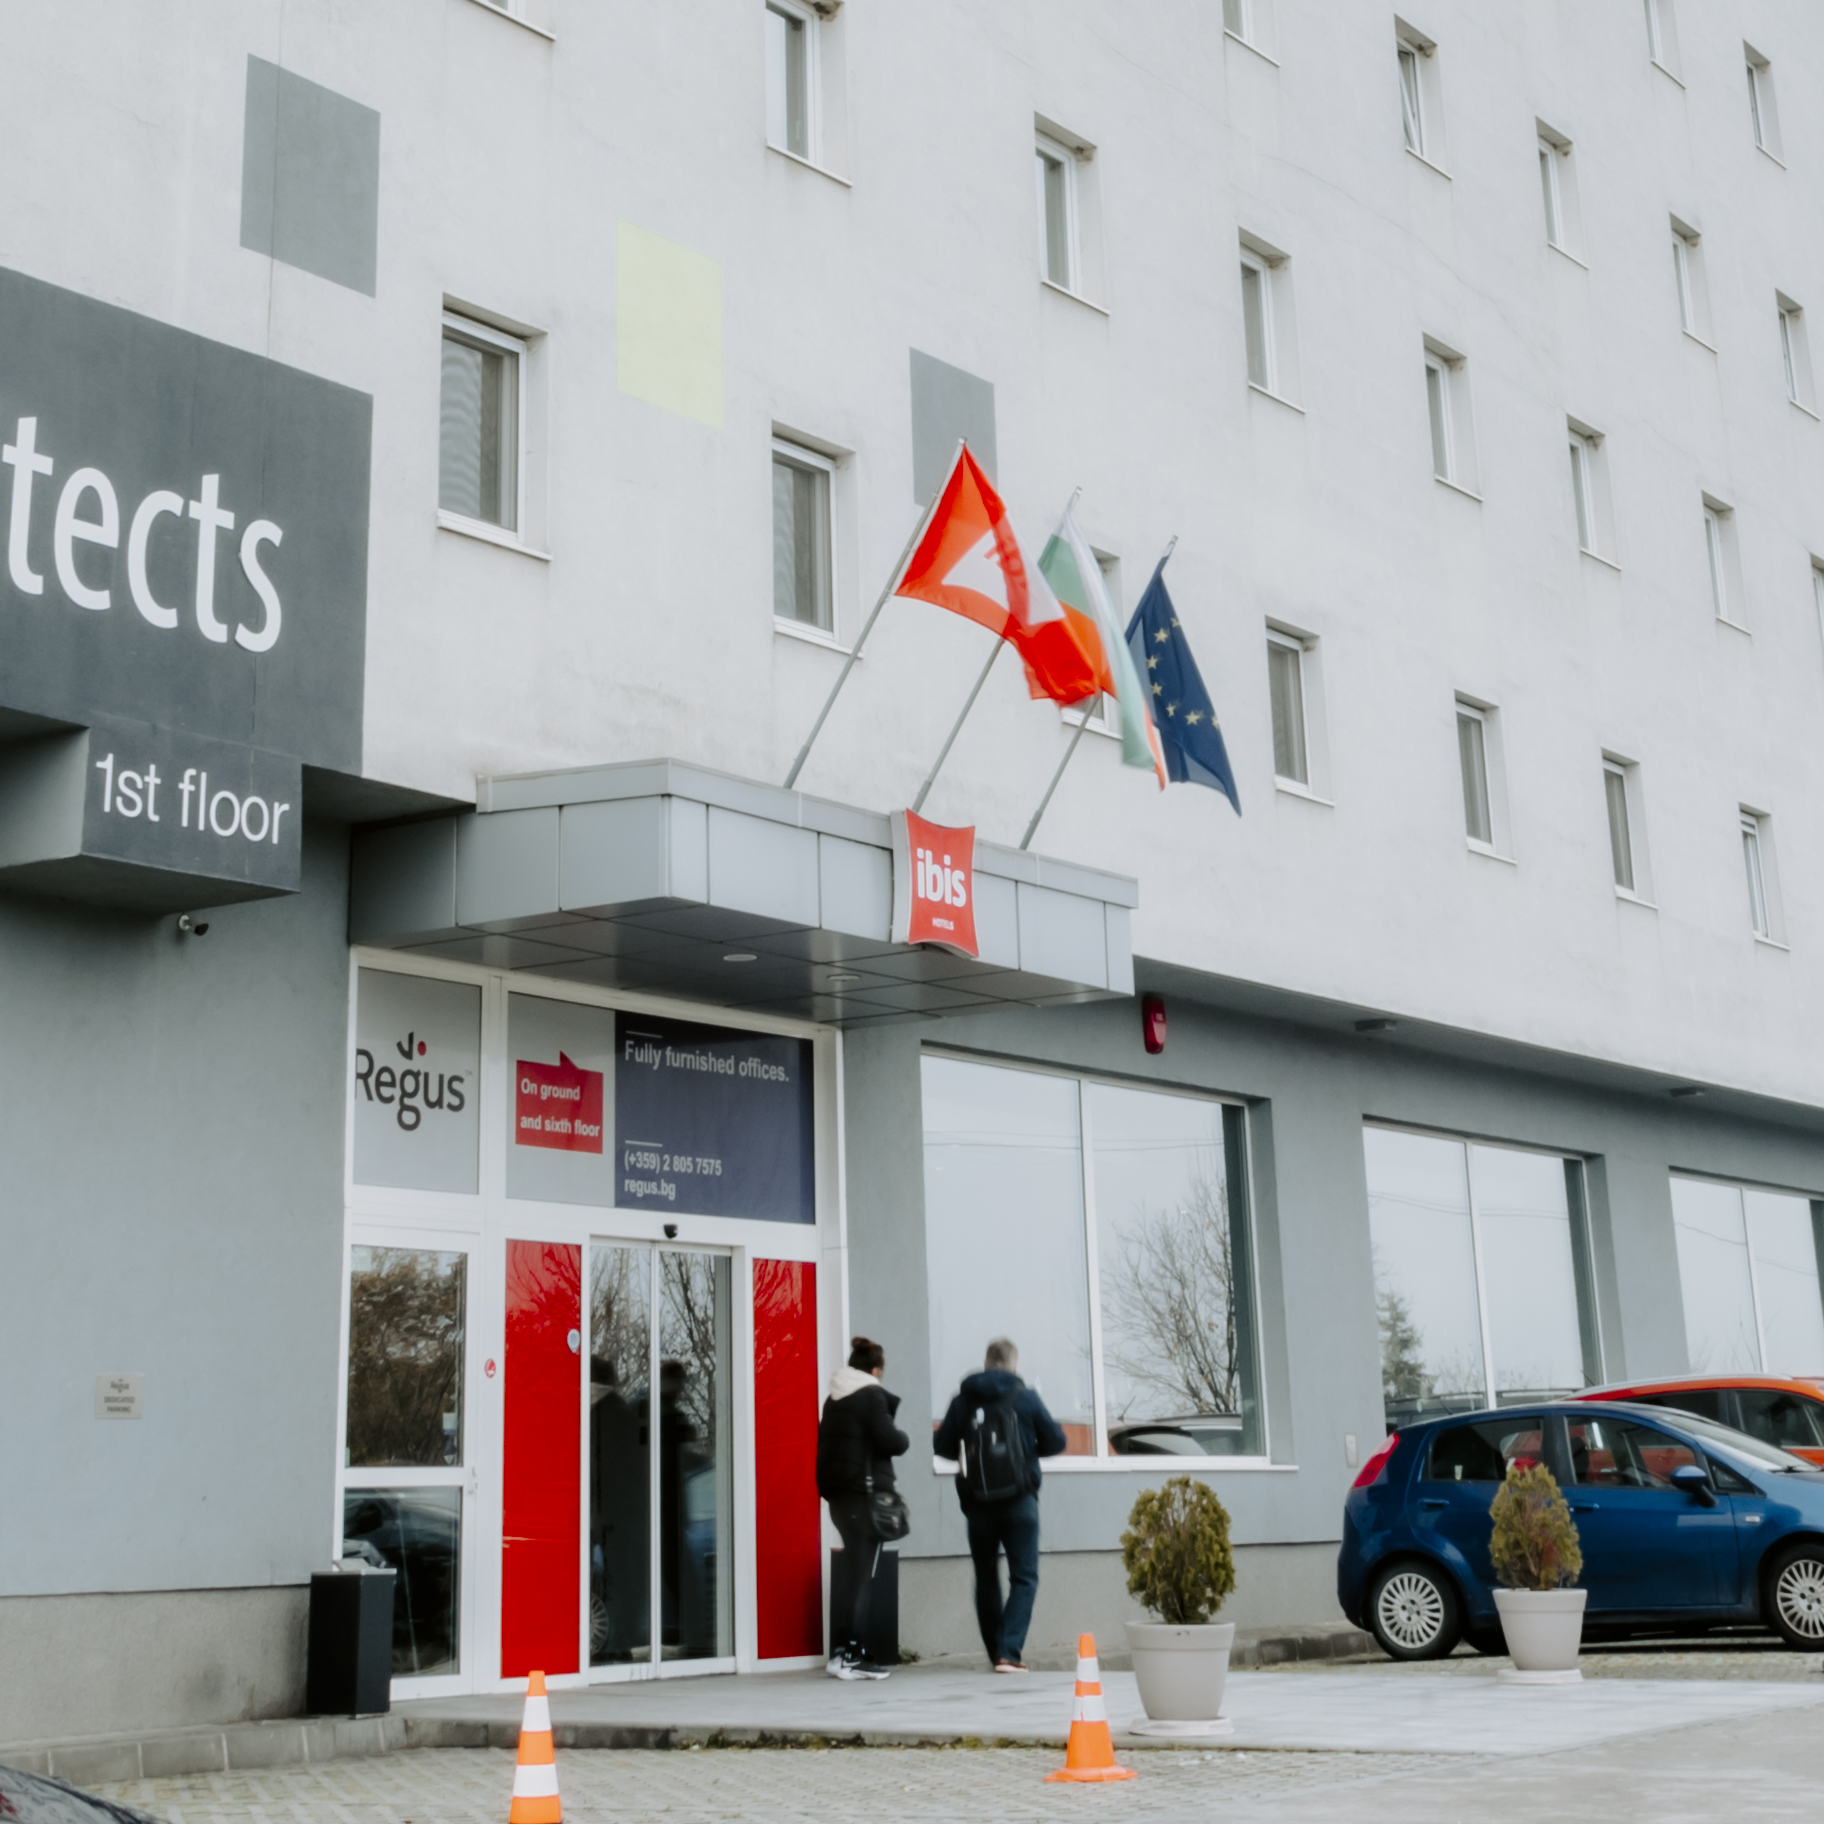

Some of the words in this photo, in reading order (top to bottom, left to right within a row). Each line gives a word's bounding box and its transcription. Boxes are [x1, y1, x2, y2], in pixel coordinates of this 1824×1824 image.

[96, 753, 161, 822] 1st
[178, 768, 290, 844] floor
[916, 848, 967, 907] ibis
[932, 917, 954, 930] HOTELS
[625, 1040, 661, 1070] Fully
[665, 1046, 735, 1075] furnished
[738, 1057, 790, 1082] offices.
[355, 1048, 465, 1132] Regus
[520, 1078, 537, 1094] On
[540, 1085, 580, 1101] ground
[520, 1115, 541, 1130] and
[544, 1117, 572, 1134] sixth
[575, 1120, 600, 1137] floor
[625, 1150, 661, 1174] (+359)
[662, 1154, 671, 1172] 2
[673, 1155, 693, 1173] 805
[695, 1158, 723, 1176] 7575
[624, 1179, 676, 1201] regus.bg
